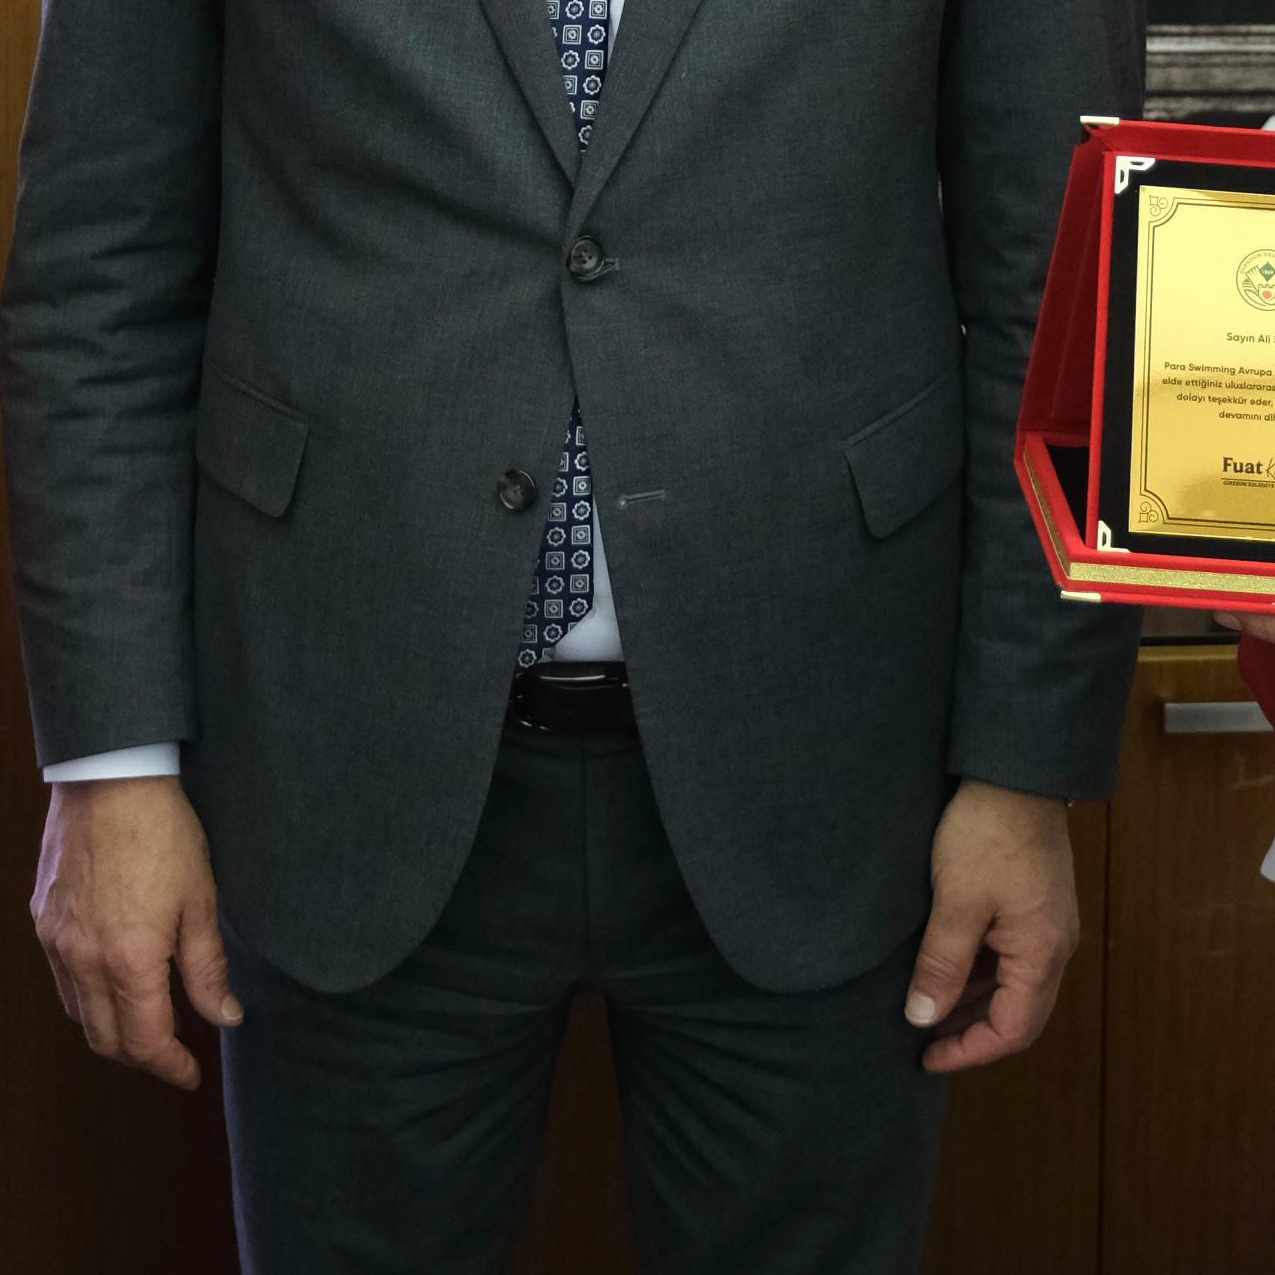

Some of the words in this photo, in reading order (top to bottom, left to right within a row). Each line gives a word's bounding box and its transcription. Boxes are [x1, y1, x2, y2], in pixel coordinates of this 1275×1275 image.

[1226, 332, 1255, 344] Sayın
[1258, 333, 1271, 344] Ali
[1164, 361, 1186, 371] Para
[1188, 363, 1236, 376] Swimming
[1237, 367, 1273, 378] Avrupa
[1162, 377, 1183, 385] elde
[1185, 378, 1223, 389] ettiğiniz
[1176, 393, 1205, 404] dolayı
[1208, 395, 1247, 406] teşekkür
[1249, 397, 1273, 408] eder,
[1218, 410, 1262, 421] devamını
[1222, 456, 1263, 475] Fuat
